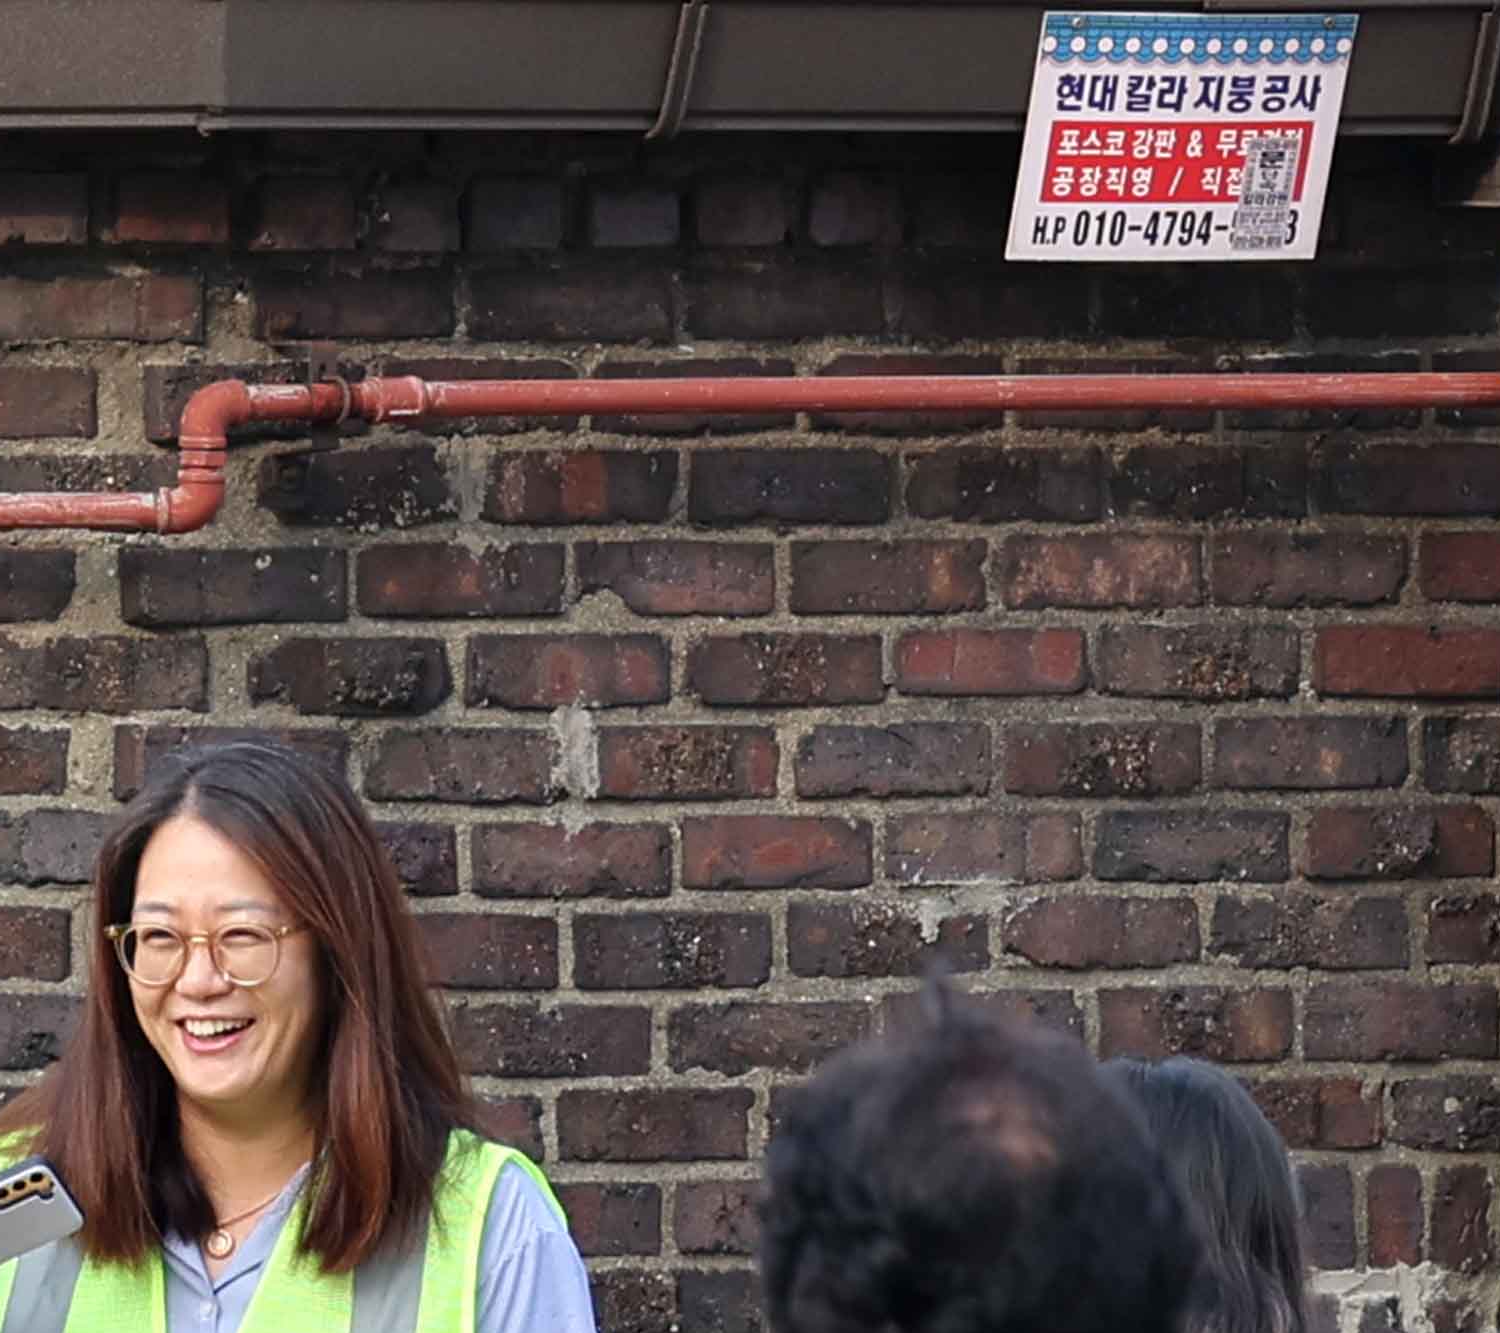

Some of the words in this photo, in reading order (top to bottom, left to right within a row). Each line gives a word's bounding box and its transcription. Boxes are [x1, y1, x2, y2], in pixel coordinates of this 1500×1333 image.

[1056, 74, 1117, 112] 현대
[1125, 75, 1188, 112] 칼라
[1057, 129, 1125, 158] 포스코
[1134, 130, 1176, 158] 강판
[1186, 134, 1203, 157] &
[1051, 166, 1154, 197] 공장직영
[1032, 215, 1065, 246] H.P
[1073, 210, 1298, 247] 010-4794-3
